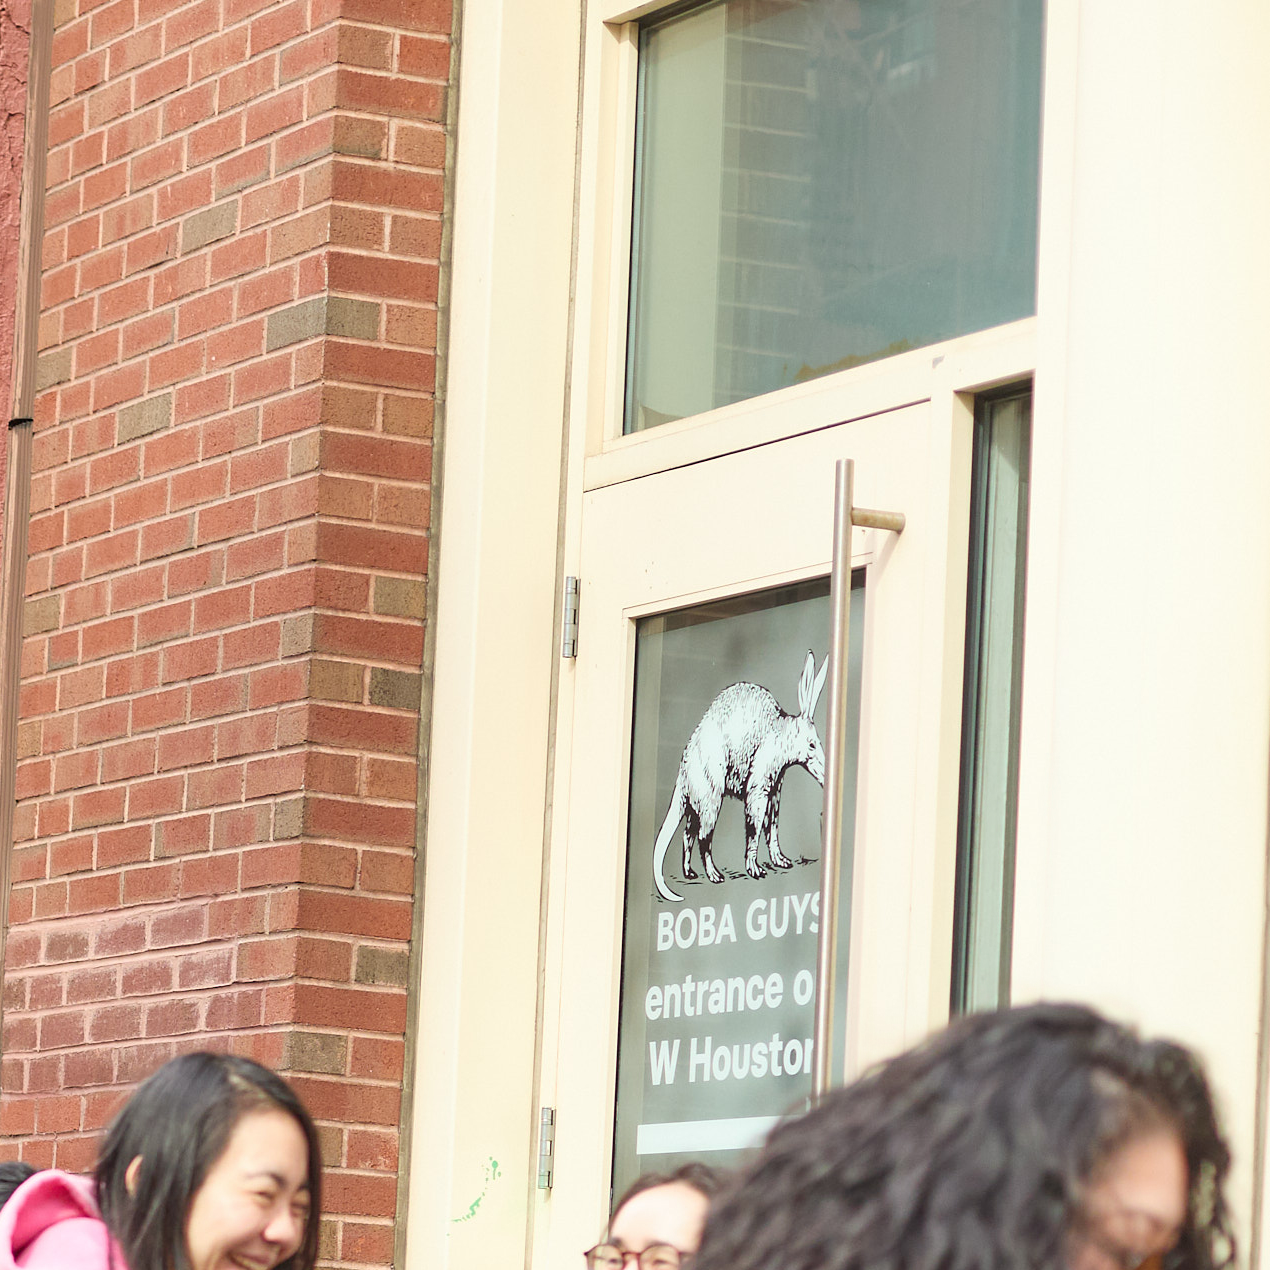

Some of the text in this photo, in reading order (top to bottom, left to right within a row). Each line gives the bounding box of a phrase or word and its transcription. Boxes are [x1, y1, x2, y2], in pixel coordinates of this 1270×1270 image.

[657, 891, 820, 951] BOBA GUYS
[645, 969, 814, 1021] entrance o
[649, 1038, 681, 1086] W
